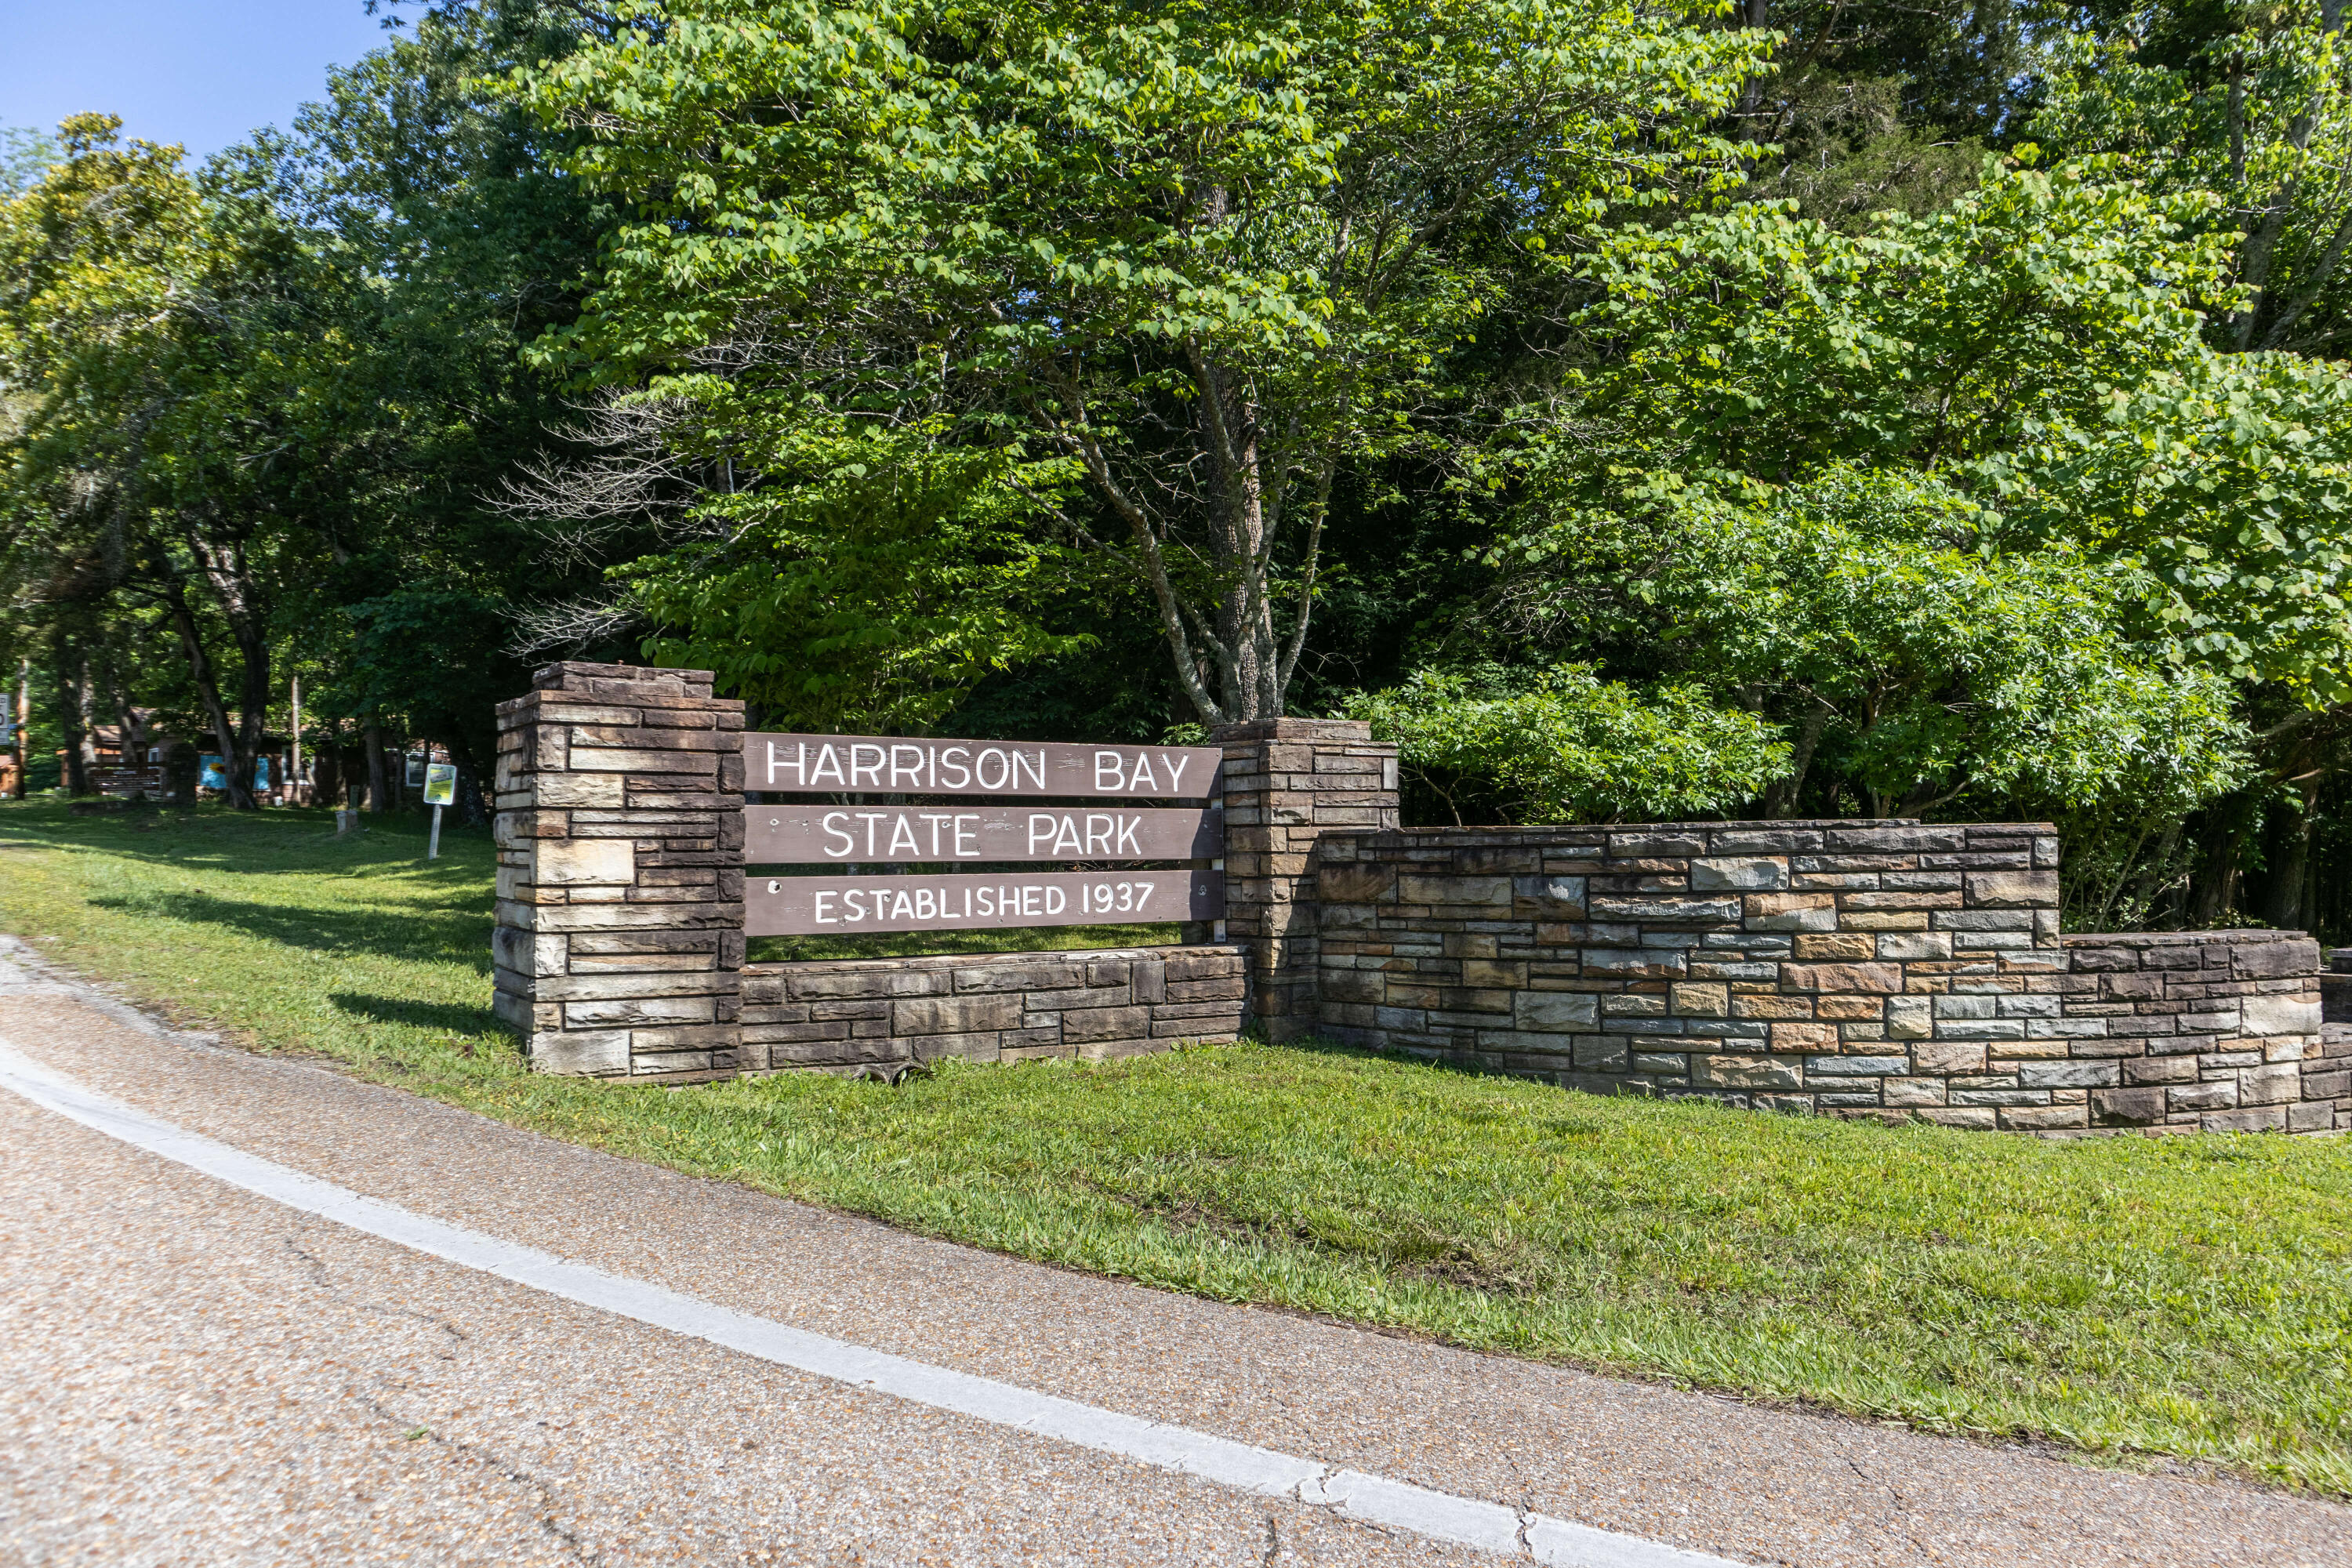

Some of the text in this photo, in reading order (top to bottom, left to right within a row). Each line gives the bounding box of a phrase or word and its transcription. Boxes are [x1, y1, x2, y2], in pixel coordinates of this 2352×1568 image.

[768, 741, 1189, 793] HARRISON BAY
[822, 811, 1142, 857] STATE PARK
[815, 882, 1155, 923] ESTABLISHED 1937
